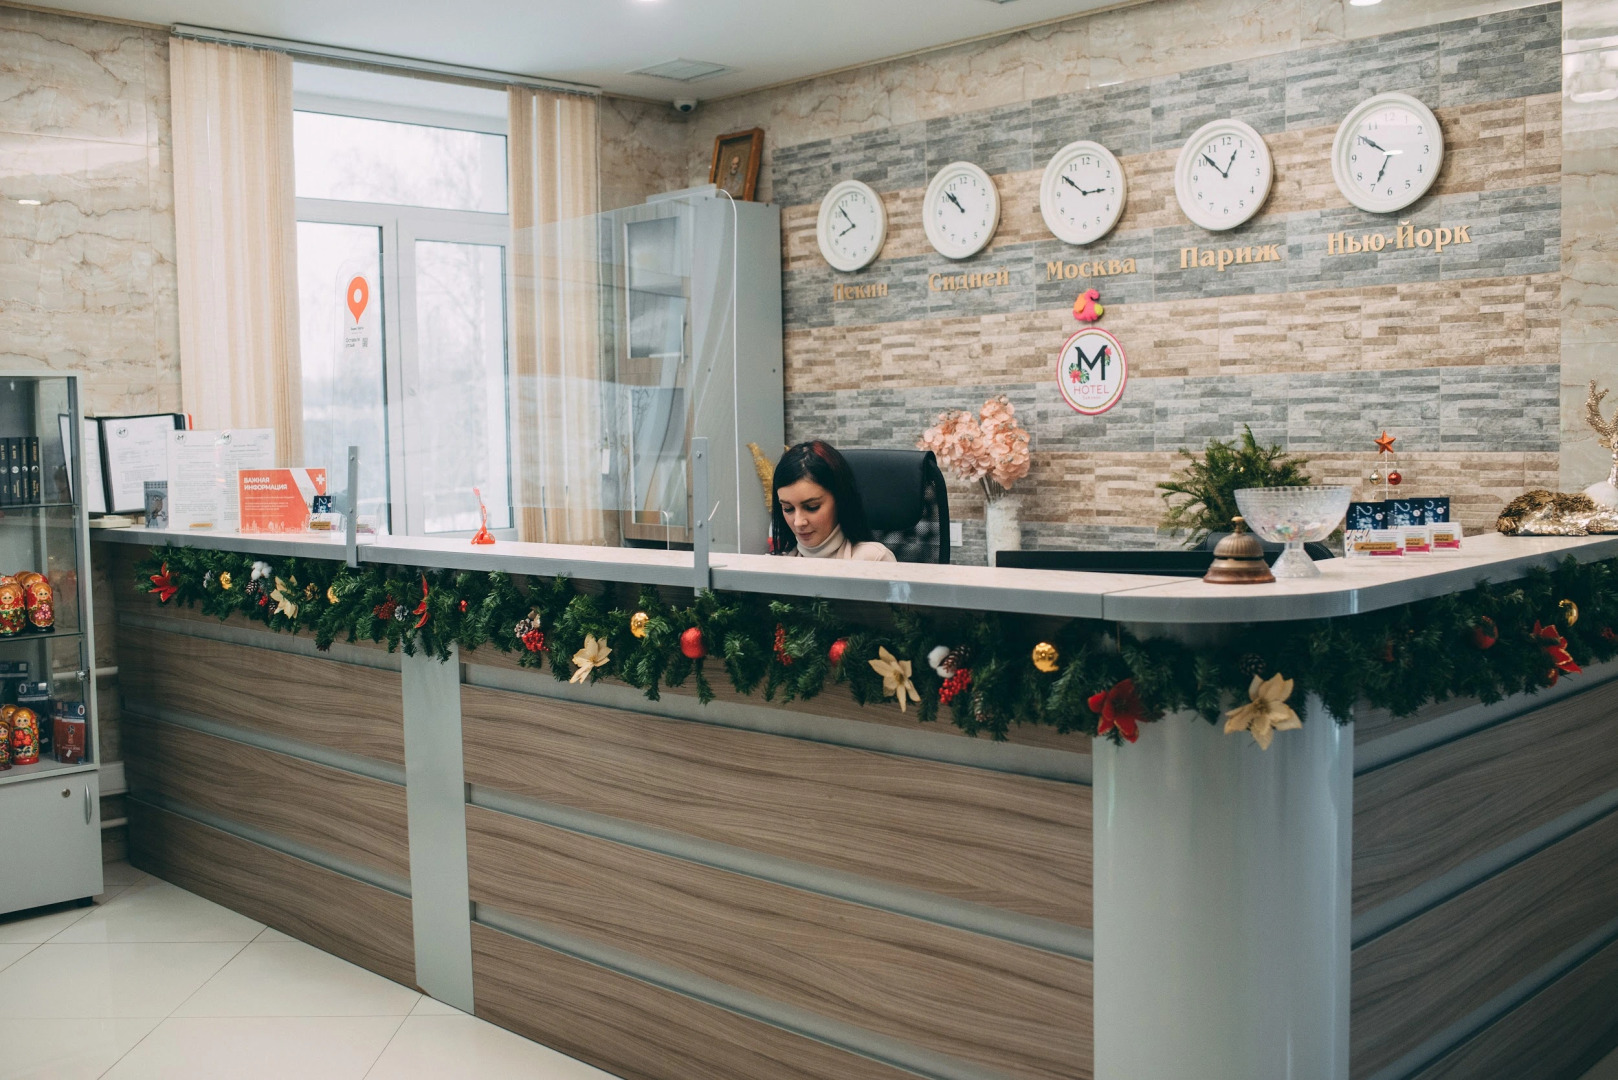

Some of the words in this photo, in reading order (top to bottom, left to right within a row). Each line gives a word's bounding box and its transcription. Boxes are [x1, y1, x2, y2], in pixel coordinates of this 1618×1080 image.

[1384, 112, 1396, 122] 12
[1404, 114, 1409, 124] 1
[1367, 121, 1379, 131] 11
[1417, 125, 1423, 135] 2
[1221, 136, 1232, 146] 12
[1239, 139, 1243, 149] 1
[1208, 144, 1217, 153] 11
[1423, 144, 1430, 155] 3
[1250, 150, 1256, 159] 2
[1351, 154, 1357, 163] 9
[1081, 156, 1091, 166] 12
[1069, 163, 1078, 172] 11
[1255, 167, 1261, 177] 3
[1417, 164, 1423, 174] 4
[1105, 170, 1111, 179] 2
[1193, 175, 1199, 183] 9
[1356, 172, 1363, 182] 8
[1370, 183, 1377, 193] 7
[1404, 179, 1411, 190] 5
[1056, 191, 1062, 199] 9
[1110, 186, 1115, 195] 3
[1249, 185, 1255, 195] 4
[1387, 187, 1393, 196] 6
[1197, 191, 1203, 201] 8
[1105, 203, 1110, 212] 4
[1208, 202, 1215, 211] 7
[1239, 199, 1245, 209] 5
[1059, 207, 1065, 216] 8
[1223, 207, 1229, 215] 6
[1069, 217, 1075, 226] 7
[1095, 216, 1101, 224] 5
[1082, 221, 1088, 230] 6
[1327, 220, 1472, 256] Нью-Йорк
[1179, 243, 1282, 272] Париж
[1046, 257, 1137, 281] Москва
[928, 265, 1010, 295] Сидней
[832, 283, 889, 301] Пекин
[1074, 344, 1108, 381] M
[1073, 384, 1110, 395] HOTEL
[243, 476, 270, 484] ВАЖНАЯ
[243, 483, 288, 491] ИНФОРМАЦИЯ
